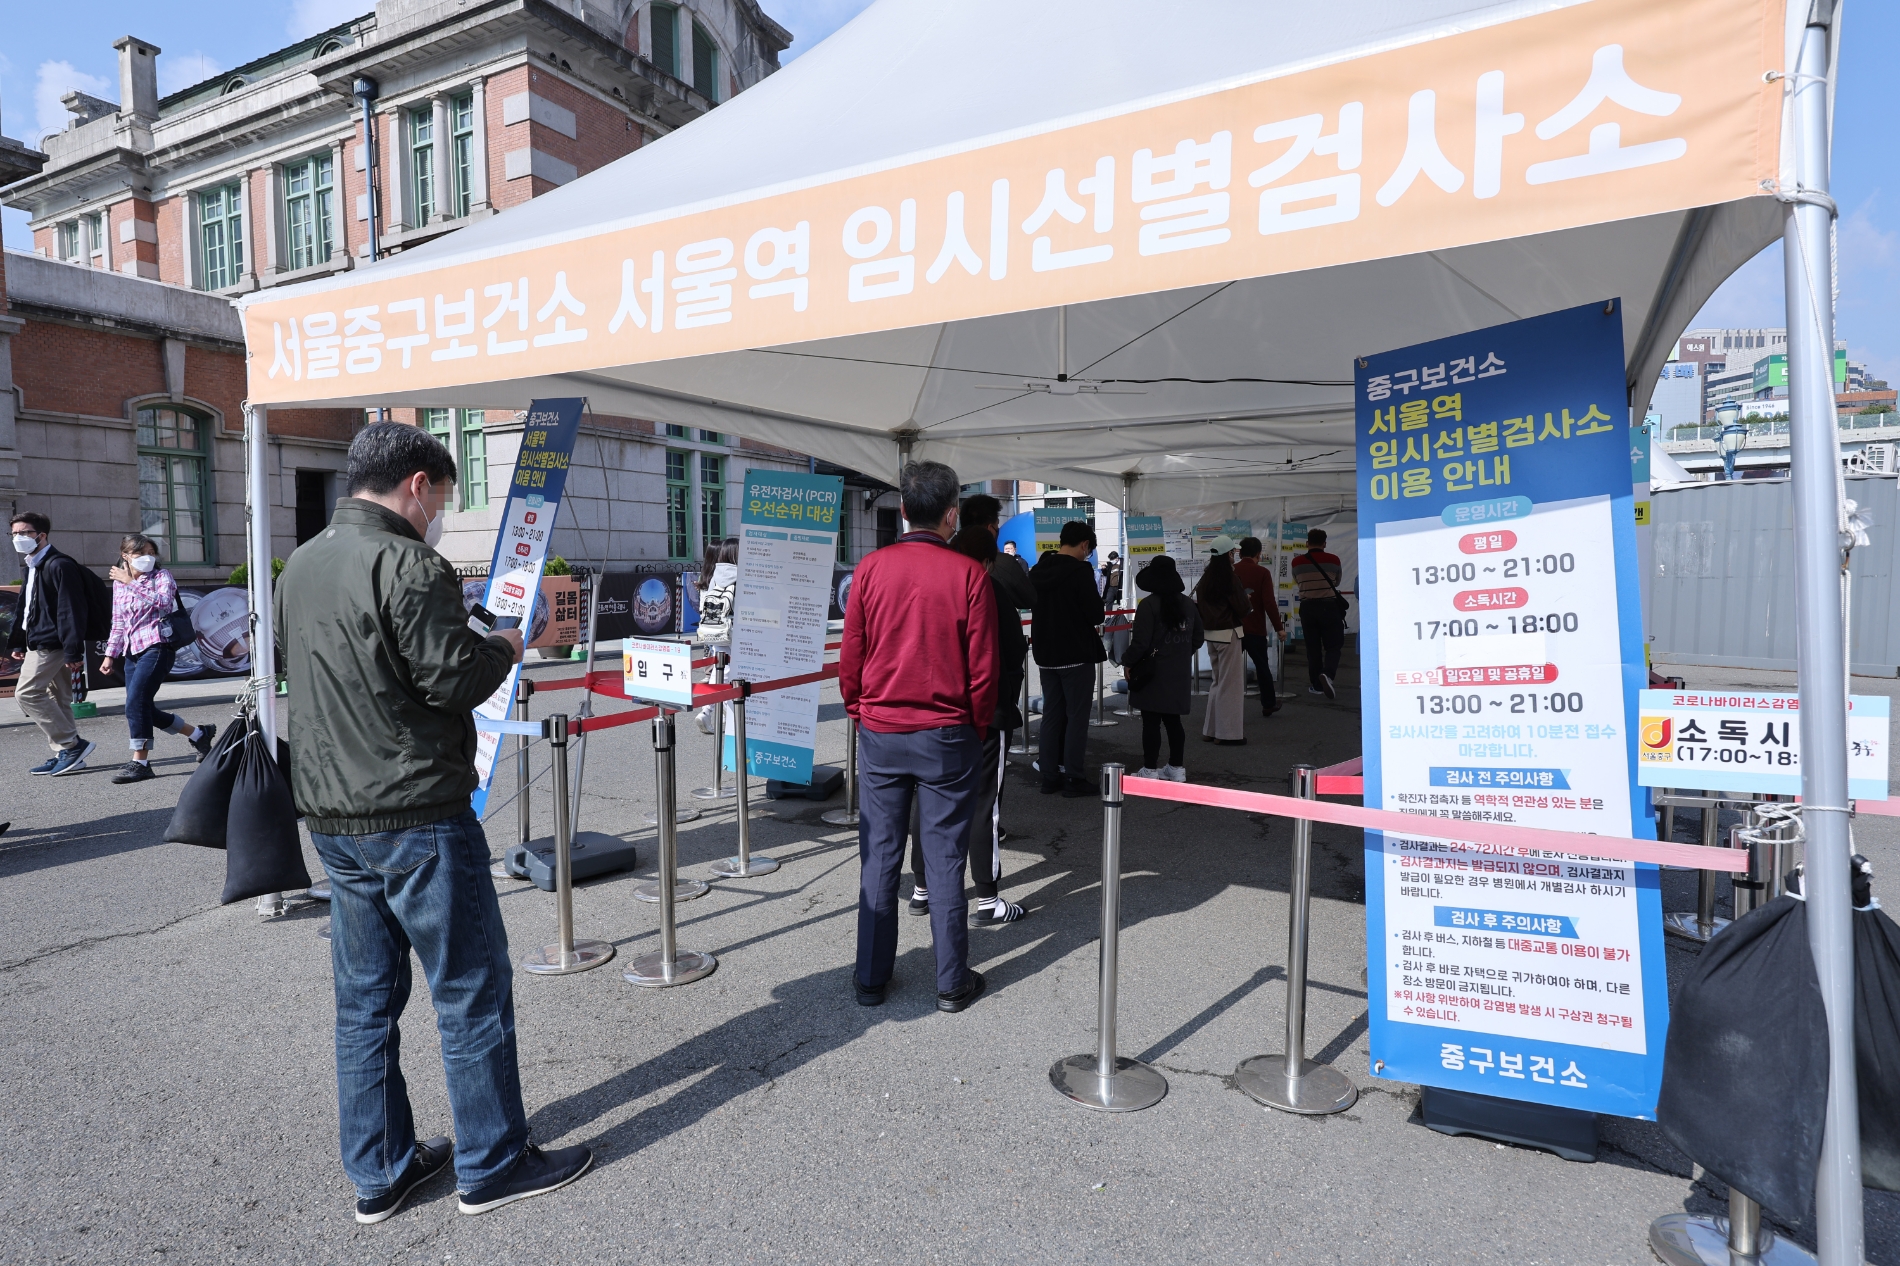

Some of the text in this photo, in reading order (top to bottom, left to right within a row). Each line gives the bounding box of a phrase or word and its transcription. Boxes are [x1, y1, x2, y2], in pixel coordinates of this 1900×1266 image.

[268, 43, 1688, 381] 서울중구보건소 서울역 임시선별검사소
[1367, 352, 1507, 401] 중구보건소
[529, 412, 559, 426] 중구보건소
[1368, 393, 1462, 435] 서울역
[524, 431, 547, 447] 서울역
[1370, 404, 1614, 470] 임시선별검사소
[520, 451, 569, 469] 임시선별검사소
[516, 470, 546, 488] 이용 안내
[1370, 455, 1511, 500] 이용 안내
[750, 485, 837, 504] 유전자검사 (PCR)
[748, 500, 834, 523] 우선순위 대상
[1455, 501, 1518, 522] 운영시간
[1473, 535, 1502, 549] 평일
[1412, 562, 1476, 585] 13:00
[1503, 552, 1575, 578] 21:00
[1464, 592, 1517, 608] 소독시간
[1414, 619, 1478, 640] 17:00
[1507, 612, 1579, 634] 18:00
[1395, 666, 1545, 684] 토요일 일요일 및 공휴일
[1416, 694, 1482, 715] 13:00
[1510, 692, 1583, 713] 21:00
[1672, 695, 1799, 710] 코로나바이러스감염
[1389, 724, 1617, 740] 검사시간을 고려하여 10분전 접수
[755, 751, 797, 768] 중구보건소
[1459, 743, 1538, 758] 마감합니다.
[1677, 746, 1801, 765] (17:00~18:
[1446, 771, 1554, 787] 검사 전 주의사항
[1398, 793, 1604, 810] 확진자 접촉자 등 역학적 연관성 있는 분은
[1452, 810, 1516, 822] 말씀해주세요.
[1400, 840, 1448, 852] 검사결과는
[1450, 842, 1514, 856] 24~72시간
[1400, 856, 1625, 881] 검사결과지는 발급되지 않으며, 검사결과지
[1400, 871, 1626, 897] 발급이 필요한 경우 병원에서 개별검사 하시기
[1400, 886, 1443, 899] 바랍니다.
[1451, 911, 1562, 934] 검사 후 주의사항
[1402, 930, 1631, 962] 검사 후 버스, 지하철 등 대중교통 이용이 불가
[1402, 944, 1435, 959] 합니다.
[1403, 960, 1631, 995] 검사 후 바로 자택으로 귀가하여야 하며, 다른
[1403, 975, 1516, 998] 장소 방문이 금지됩니다.
[1403, 1006, 1460, 1023] 수 있습니다.
[1416, 992, 1436, 1004] 사항
[1438, 994, 1480, 1009] 위반하여
[1483, 1000, 1516, 1014] 감염병
[1519, 1003, 1541, 1017] 발생
[1545, 1006, 1555, 1019] 시
[1558, 1008, 1593, 1023] 구상권
[1596, 1012, 1633, 1029] 청구될
[1441, 1043, 1588, 1088] 중구보건소
